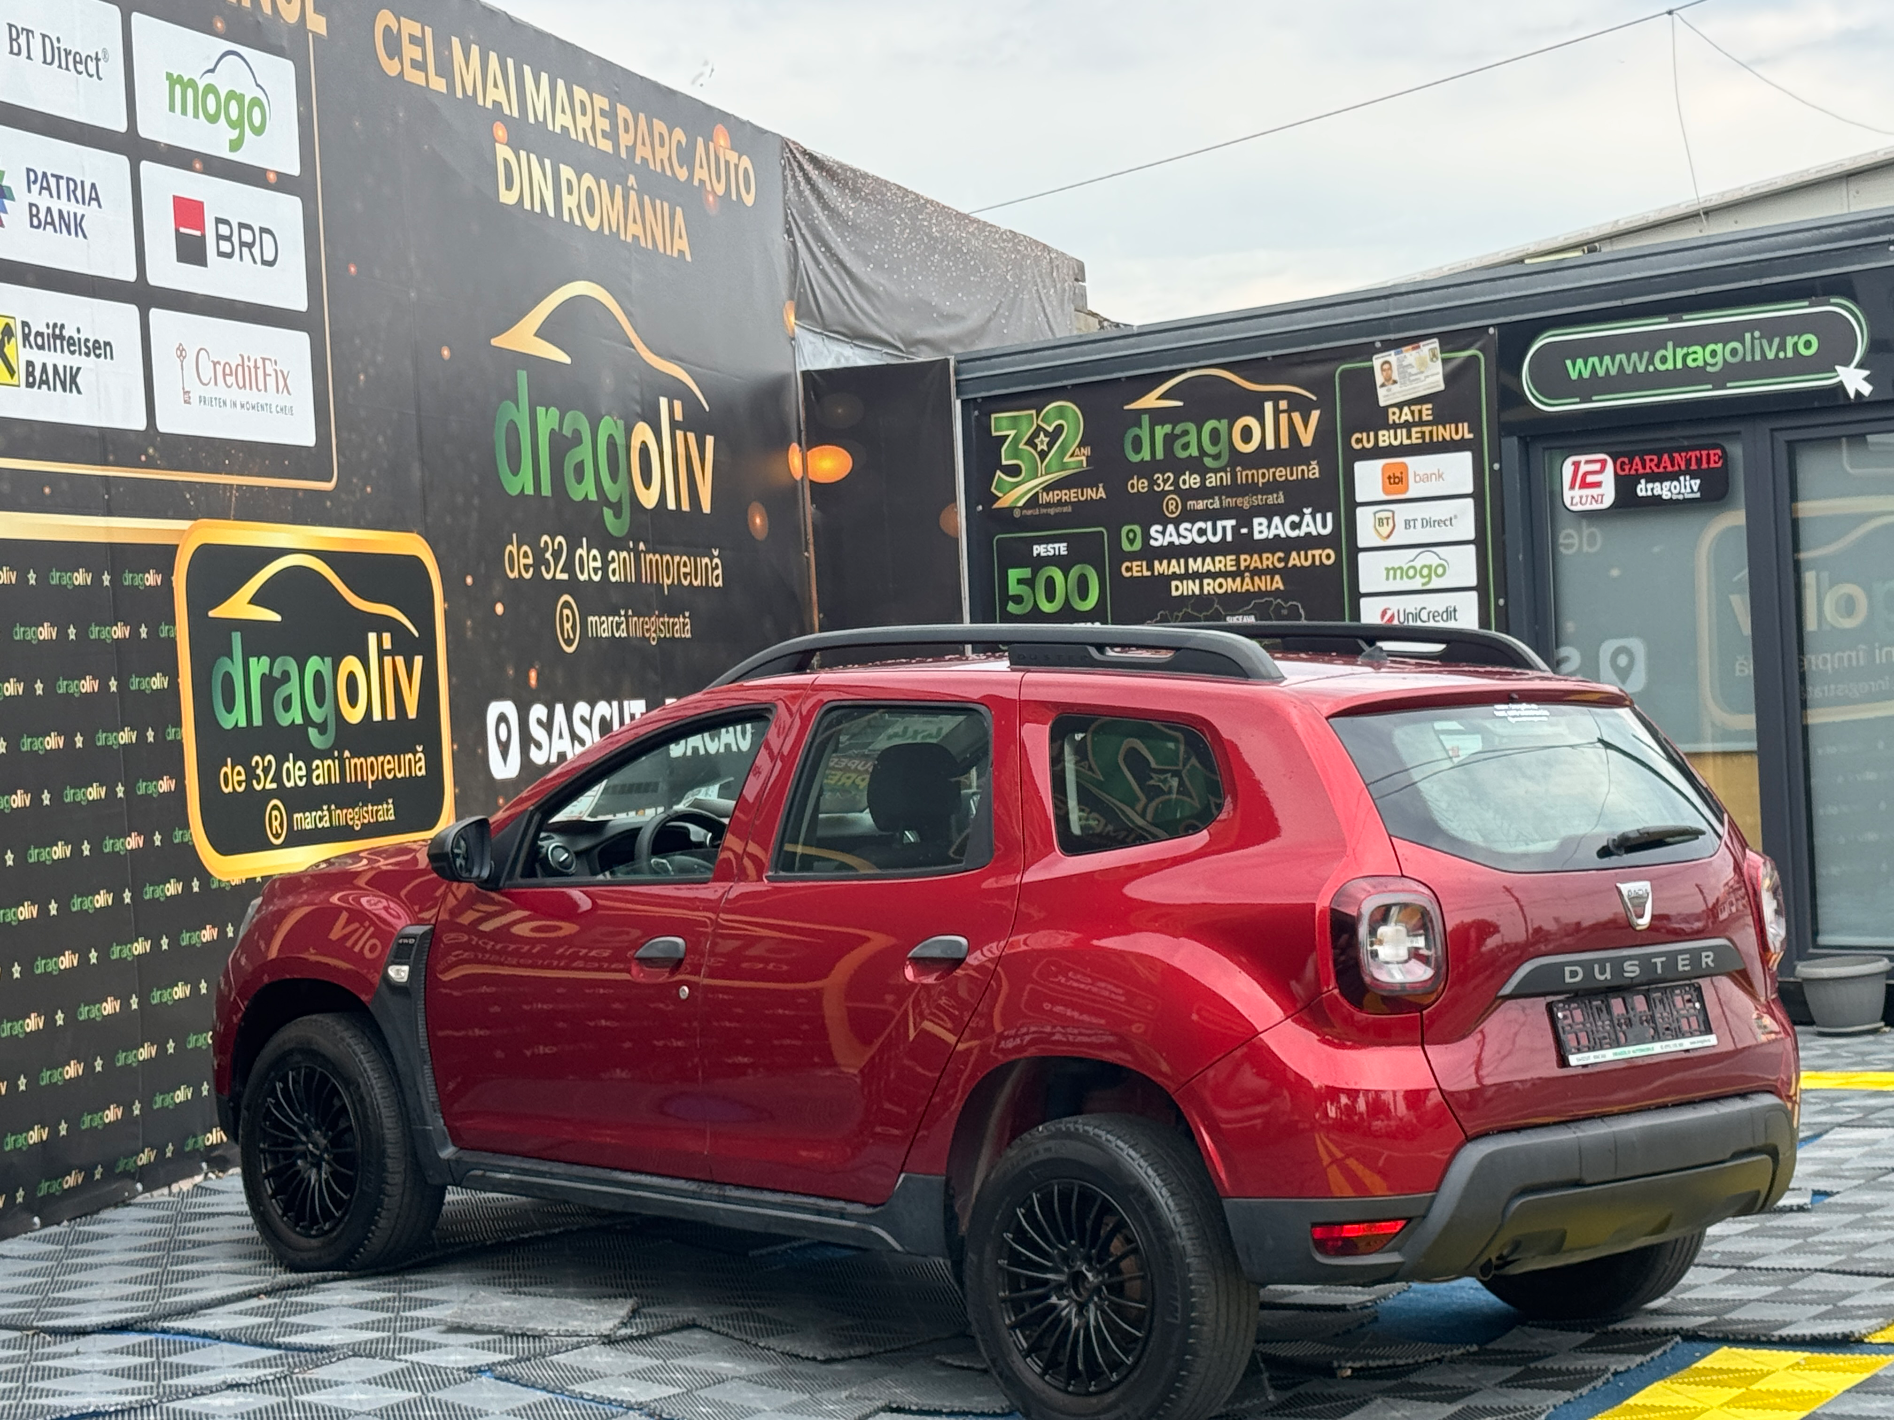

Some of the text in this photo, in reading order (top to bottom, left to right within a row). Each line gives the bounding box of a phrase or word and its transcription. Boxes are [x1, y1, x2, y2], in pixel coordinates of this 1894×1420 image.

[7, 23, 35, 62] BT
[165, 71, 267, 153] mogo
[374, 9, 447, 94] CEL
[451, 35, 520, 119] MAI
[523, 64, 614, 154] MARE
[617, 103, 688, 182] PARC
[693, 136, 756, 208] AUTO
[25, 167, 103, 209] PATRIA
[495, 142, 692, 263] DIN ROMÂNIA
[28, 202, 88, 241] BANK
[214, 216, 279, 268] BRD
[21, 320, 114, 361] Raiffeisen
[1565, 331, 1819, 381] www.dragoliv.ro
[25, 360, 83, 395] BANK
[195, 347, 292, 396] CreditFix
[198, 395, 227, 408] PRIETEN
[230, 399, 237, 409] IN
[240, 401, 273, 414] MOMENTE
[1388, 404, 1433, 424] RATE
[1123, 399, 1321, 469] dragoliv
[1351, 422, 1474, 449] CU BULETINUL
[495, 370, 715, 538] dragoliv
[1074, 446, 1091, 457] ANI
[1616, 449, 1723, 476] GARANTIE
[1127, 460, 1320, 494] de 32 de ani împreună
[1386, 469, 1445, 485] tbi bank
[1568, 458, 1608, 491] 12
[1636, 475, 1701, 500] dragoliv
[1187, 497, 1221, 511] marcă
[1222, 492, 1285, 510] înregistrată
[1570, 494, 1605, 507] LUNI
[1149, 519, 1237, 548] SASCUT
[1253, 508, 1333, 540] BACĂU
[1377, 517, 1391, 528] BT
[1404, 518, 1418, 530] BT
[504, 533, 723, 595] de 32 de ani împreună
[1033, 543, 1068, 557] PESTE
[1121, 548, 1336, 578] CEL MAI MARE PARC AUTO
[49, 568, 93, 590] dragoliv
[122, 569, 162, 590] dragoliv
[1006, 564, 1099, 615] 500
[1171, 574, 1284, 597] DIN ROMÂNIA
[1385, 562, 1447, 587] mogo
[588, 609, 627, 639] marcă
[628, 609, 692, 645] înregistrată
[1397, 606, 1459, 625] UniCredit
[12, 622, 131, 644] dragoliv dragoliv
[56, 675, 99, 697] dragoliv
[129, 672, 169, 694] dragoliv
[212, 631, 424, 750] dragoliv
[20, 726, 137, 754] dragoliv dragoliv
[220, 745, 426, 794] de 32 de ani împreună
[63, 782, 107, 805] dragoliv
[136, 776, 176, 797] dragoliv
[293, 808, 330, 831] marcă
[331, 799, 395, 831] înregistrată
[27, 841, 72, 865] dragoliv
[102, 832, 144, 855] dragoliv
[70, 890, 114, 913] dragoliv
[143, 878, 183, 901] dragoliv
[34, 924, 218, 975] dragoliv dragoliv dragoliv
[1564, 951, 1715, 984] DUSTER
[1, 982, 192, 1038] dragoliv dragoliv dragoliv
[39, 1060, 84, 1086] dragoliv
[115, 1042, 157, 1067] dragoliv
[3, 1085, 193, 1151] dragoliv dragoliv dragoliv
[37, 1170, 84, 1197] dragoliv
[115, 1148, 157, 1174] dragoliv
